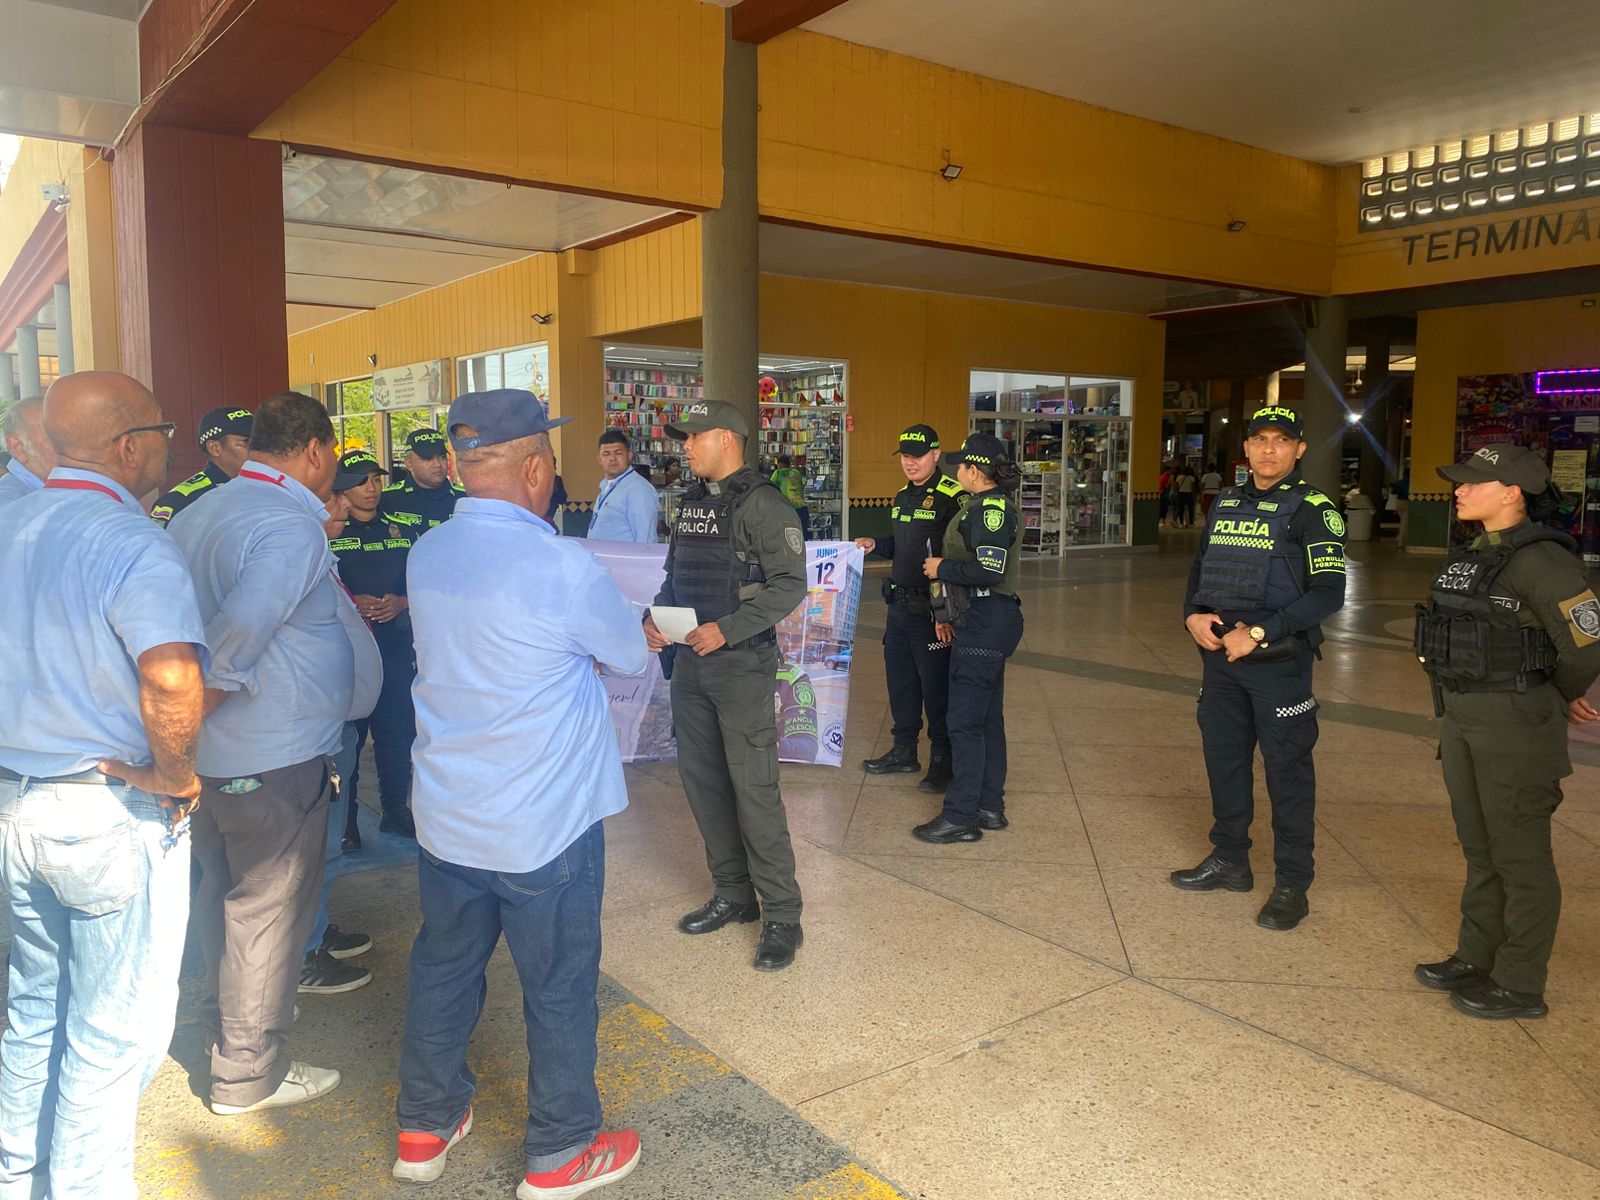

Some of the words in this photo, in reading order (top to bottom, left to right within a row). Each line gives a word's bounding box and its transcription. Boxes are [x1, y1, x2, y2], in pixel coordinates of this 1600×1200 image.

[1402, 208, 1600, 266] TERMINA
[681, 507, 716, 520] GAULA
[1213, 518, 1270, 537] POLICÍA
[815, 548, 838, 559] JUNIO
[815, 561, 835, 585] 12
